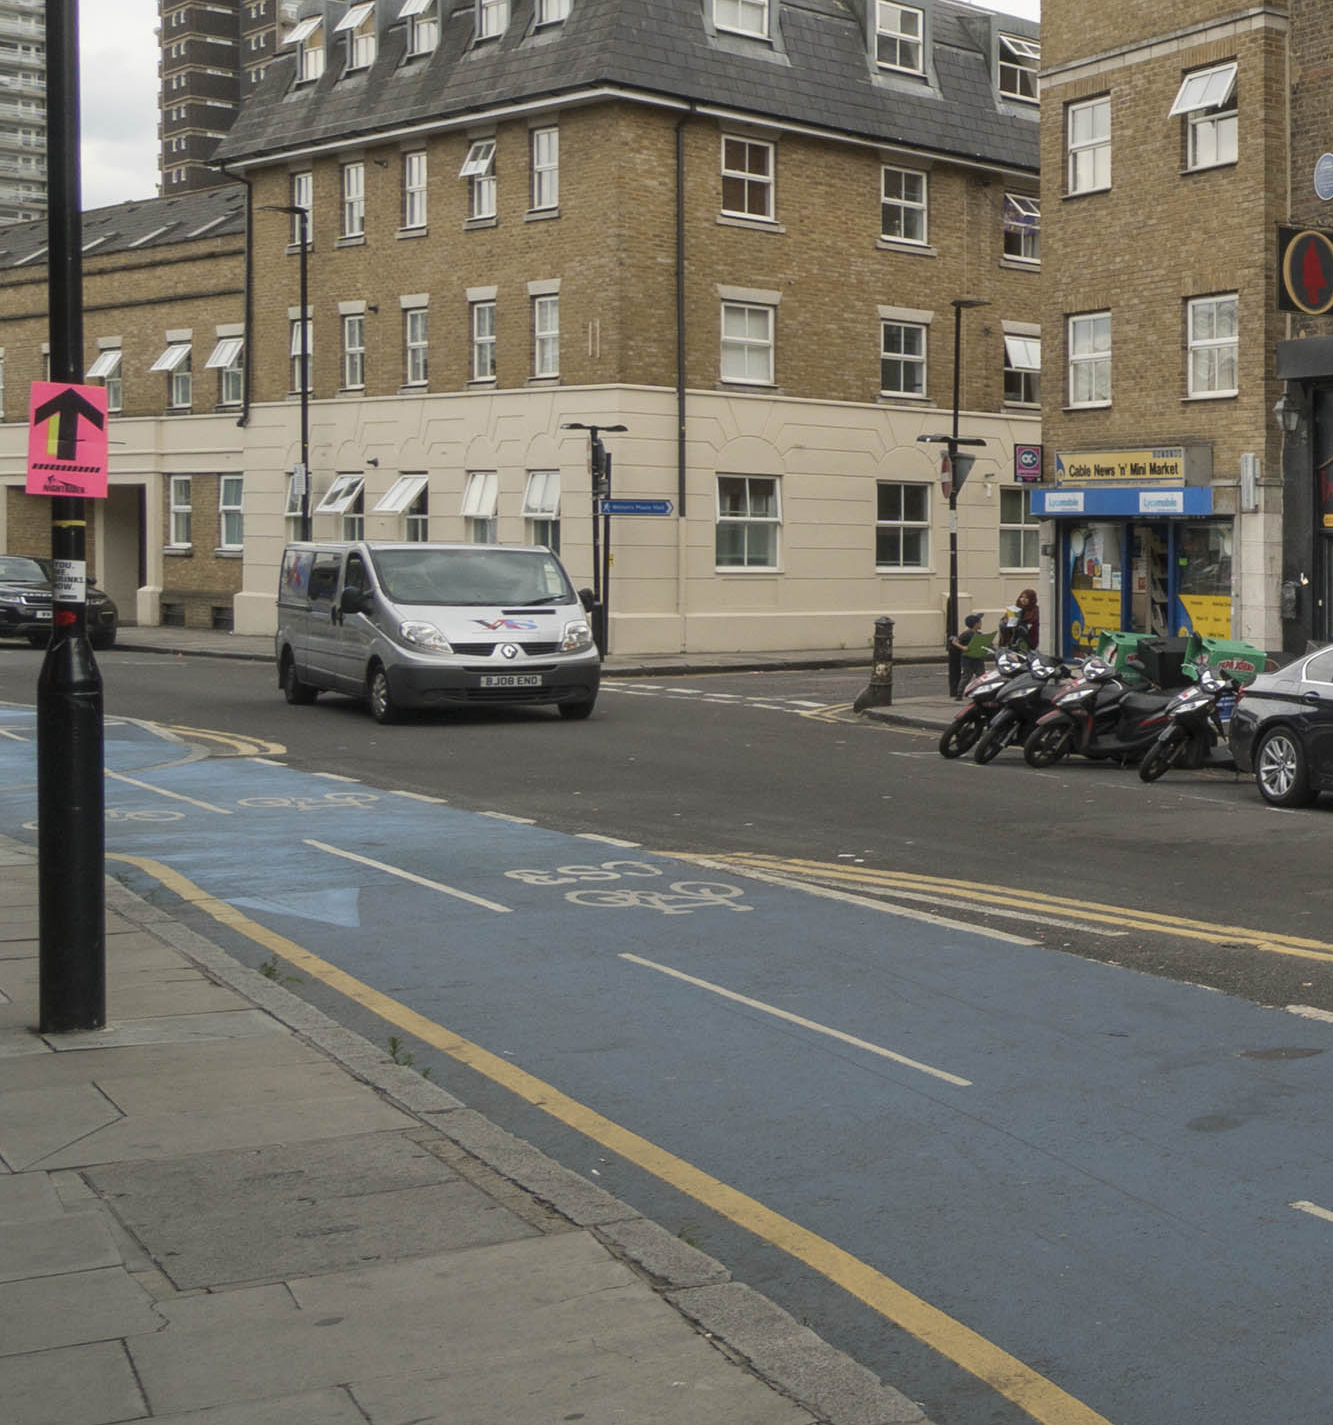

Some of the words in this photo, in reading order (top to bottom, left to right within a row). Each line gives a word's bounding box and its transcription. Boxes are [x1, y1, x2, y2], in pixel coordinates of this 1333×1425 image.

[1068, 463, 1091, 477] Cable
[1093, 463, 1116, 477] News
[1129, 461, 1147, 476] Mini
[1149, 461, 1179, 475] Market
